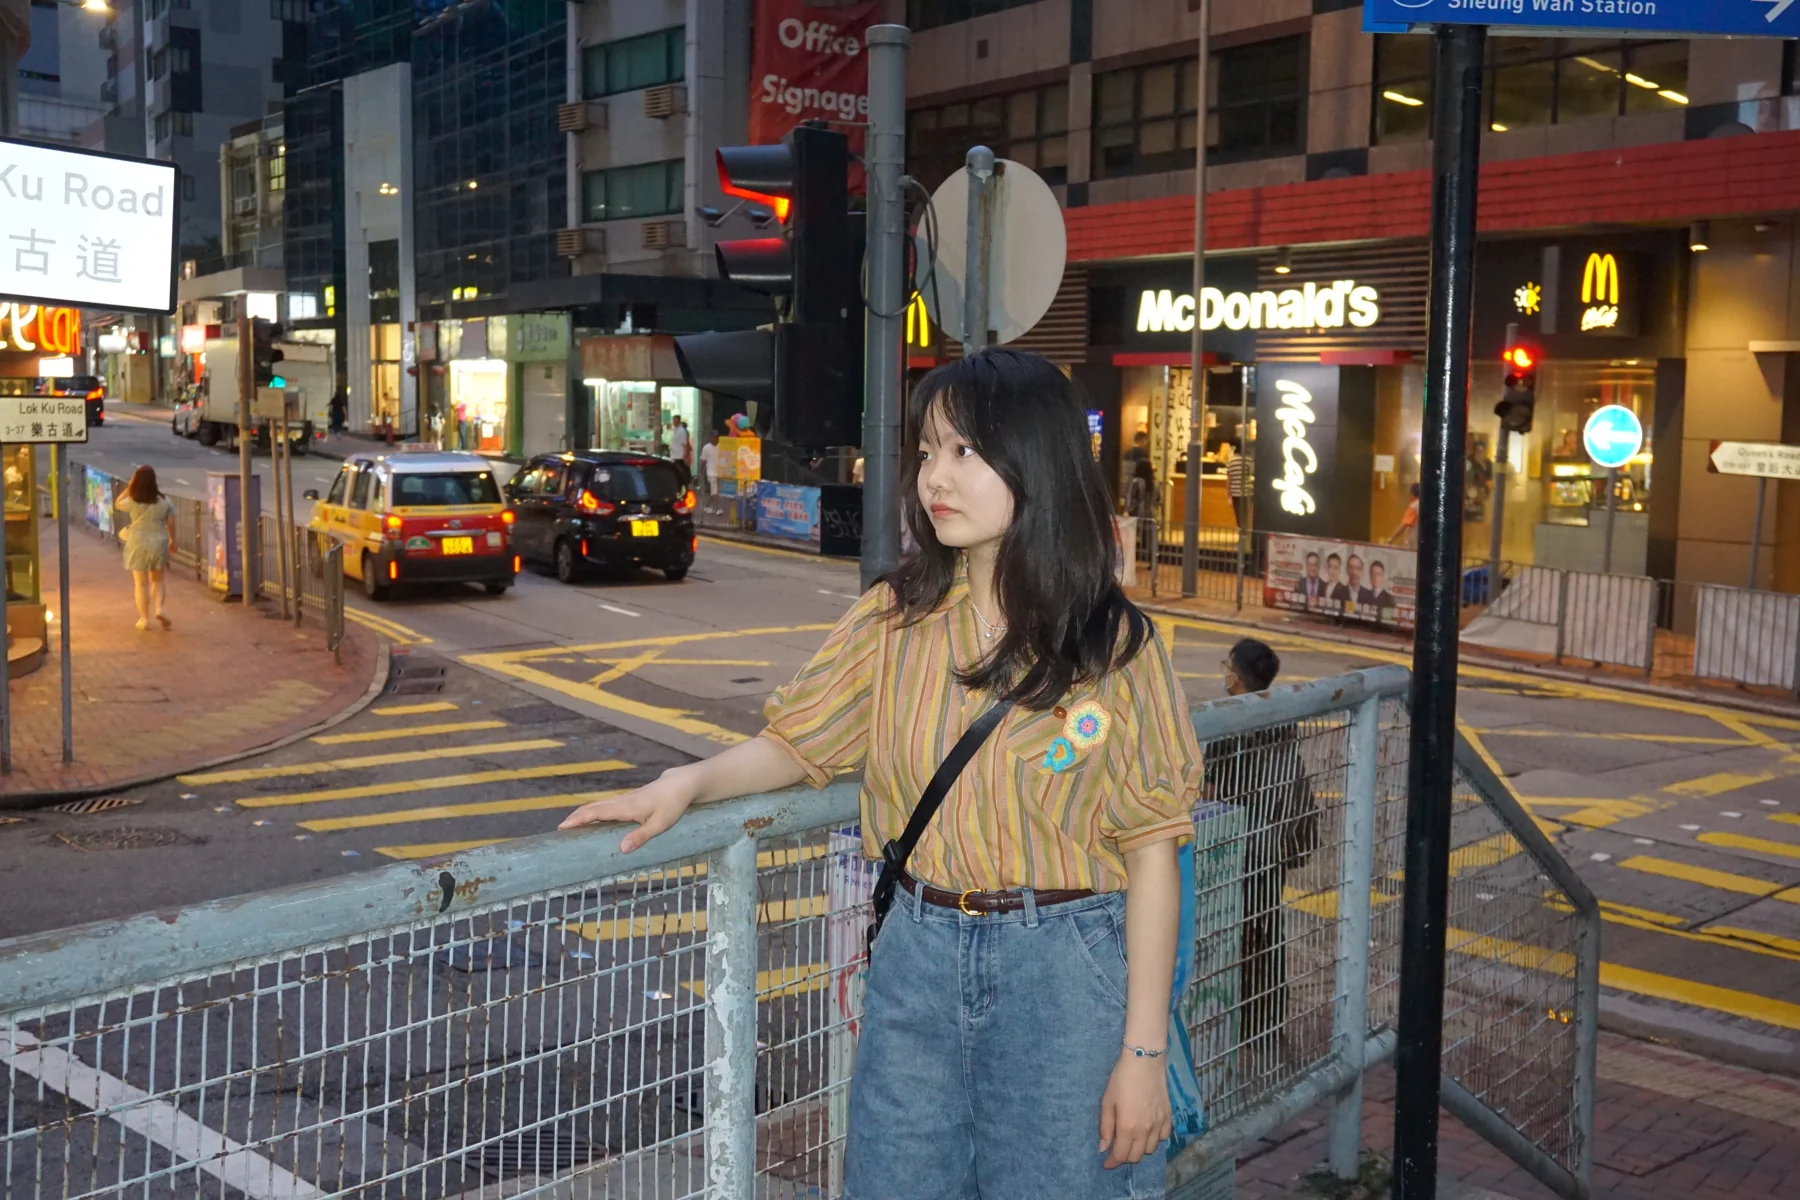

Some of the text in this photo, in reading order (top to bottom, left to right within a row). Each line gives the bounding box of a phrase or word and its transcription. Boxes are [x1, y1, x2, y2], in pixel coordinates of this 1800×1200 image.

[1532, 0, 1574, 11] Wan
[1581, 0, 1656, 15] Station
[778, 18, 860, 56] Office
[761, 74, 869, 120] Signage
[64, 172, 163, 217] Road
[9, 228, 122, 283] 古道
[1136, 279, 1379, 332] McDonald's
[20, 402, 83, 414] Lok Ku Road
[5, 421, 73, 437] 3-37 樂古道
